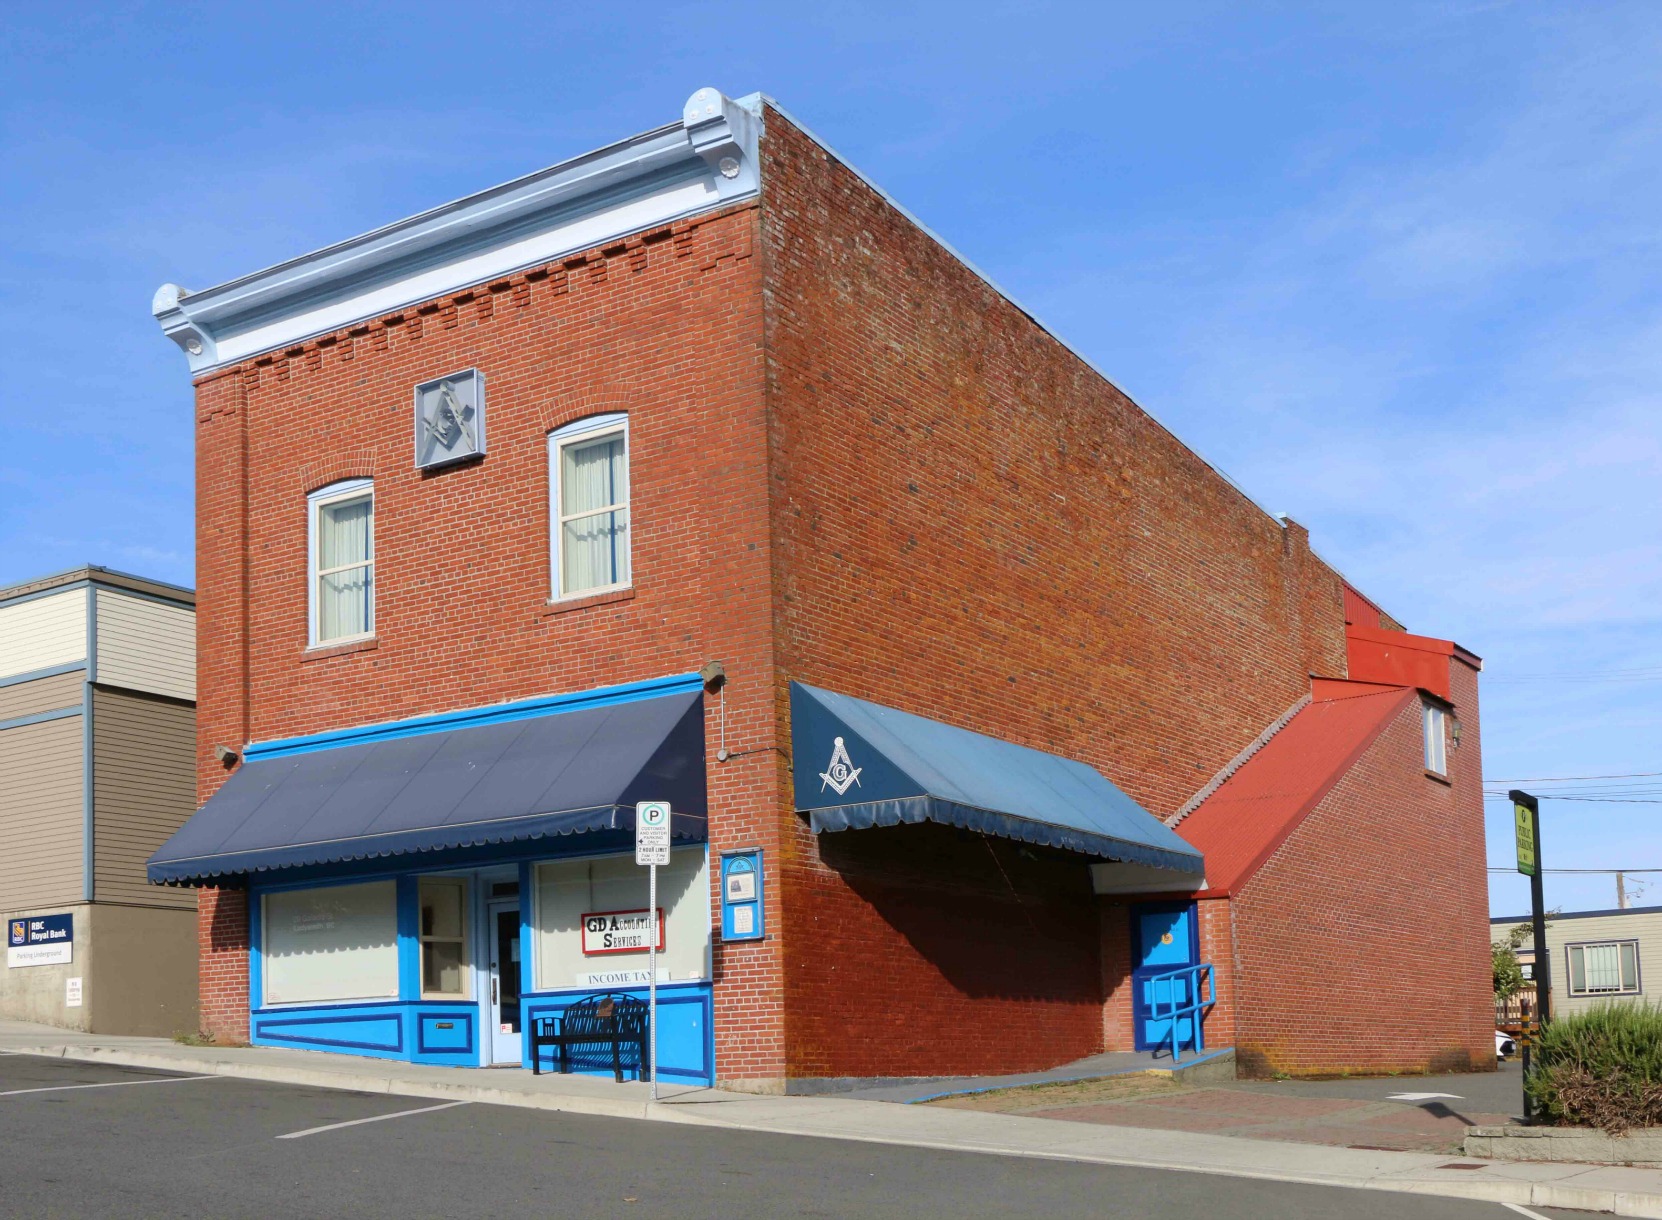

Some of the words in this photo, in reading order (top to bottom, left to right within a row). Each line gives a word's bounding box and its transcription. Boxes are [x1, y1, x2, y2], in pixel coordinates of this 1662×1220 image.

[649, 810, 659, 821] P
[31, 921, 44, 931] RBC
[586, 917, 607, 932] GD
[609, 916, 657, 932] ACCOUNTI
[31, 931, 49, 941] Royal
[50, 929, 66, 939] Bank
[603, 933, 642, 948] SERVICES
[588, 973, 631, 985] INCOME
